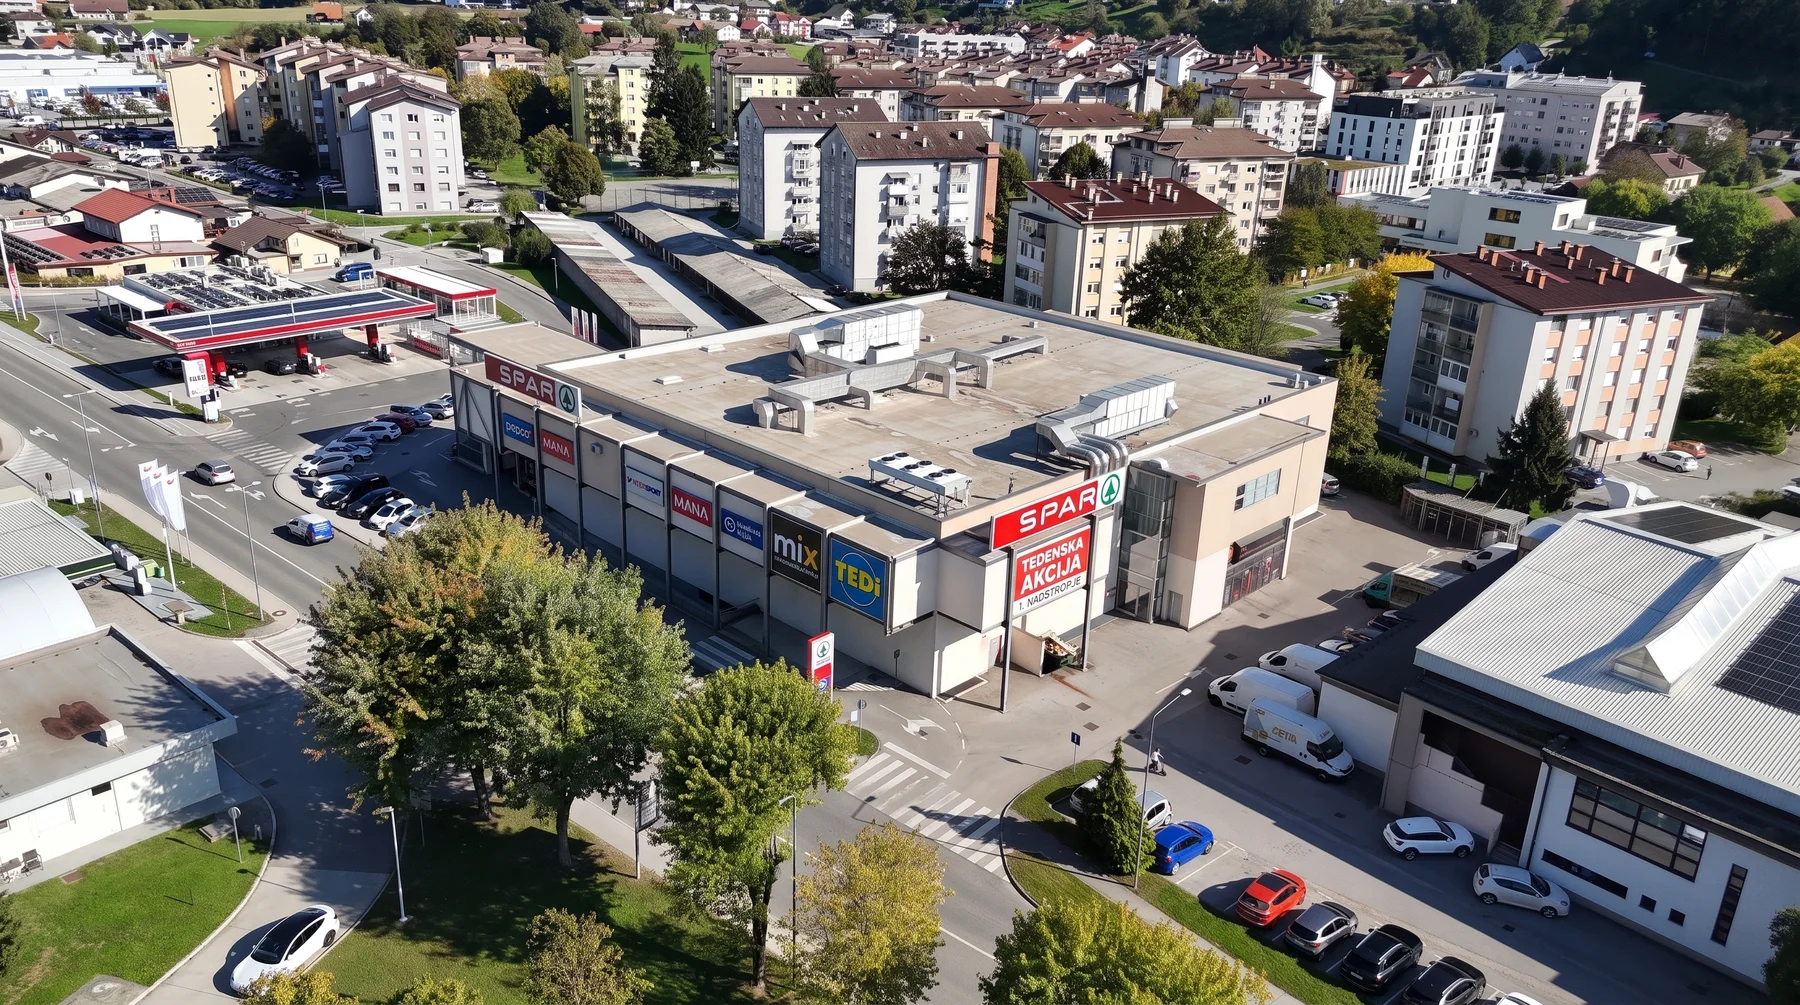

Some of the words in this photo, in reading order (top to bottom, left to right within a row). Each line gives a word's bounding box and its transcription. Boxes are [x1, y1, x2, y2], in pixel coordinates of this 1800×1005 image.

[500, 364, 554, 401] SPAR
[505, 421, 530, 439] pepco
[543, 437, 570, 458] MANA
[674, 494, 709, 521] MANA
[1019, 486, 1096, 534] SPAR
[774, 534, 819, 571] mix
[1021, 536, 1084, 573] TEDENSKA
[835, 559, 881, 598] TEDi
[1020, 553, 1082, 595] AKCIJA
[1018, 602, 1025, 611] 1.
[1027, 575, 1081, 607] NADSTROPJE
